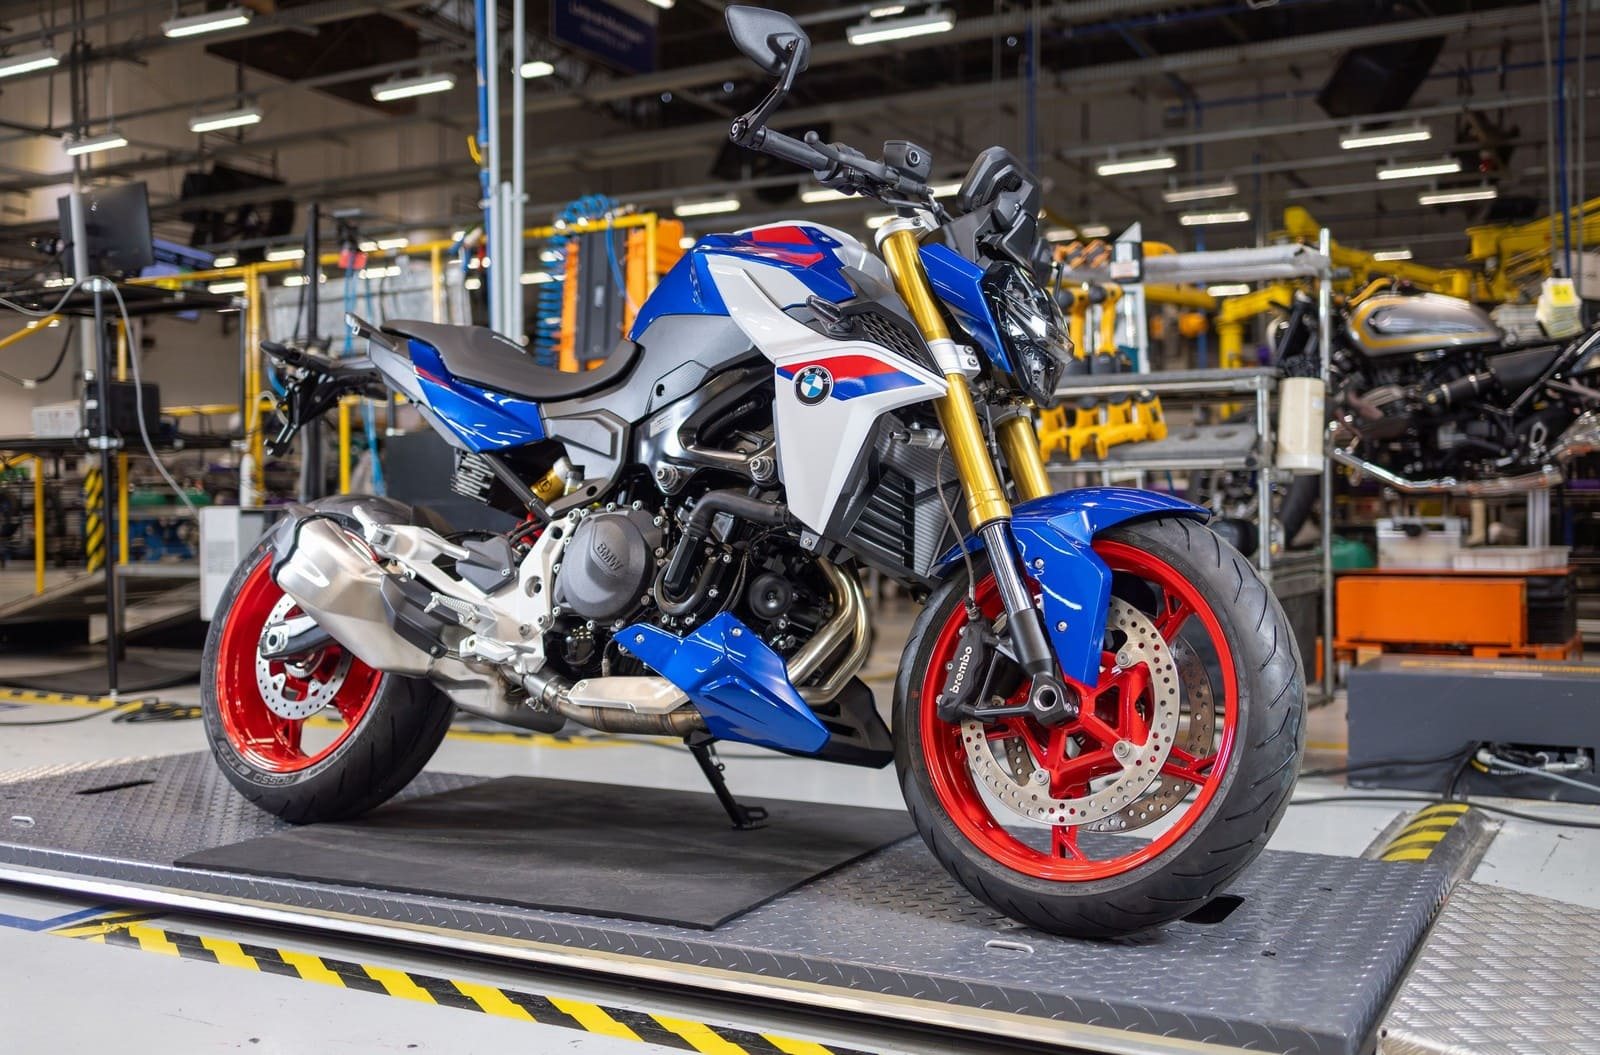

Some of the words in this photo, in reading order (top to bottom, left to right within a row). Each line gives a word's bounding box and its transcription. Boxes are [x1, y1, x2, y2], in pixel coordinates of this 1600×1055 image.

[804, 367, 830, 385] BMW
[597, 542, 624, 571] BMW
[949, 646, 973, 694] brembo
